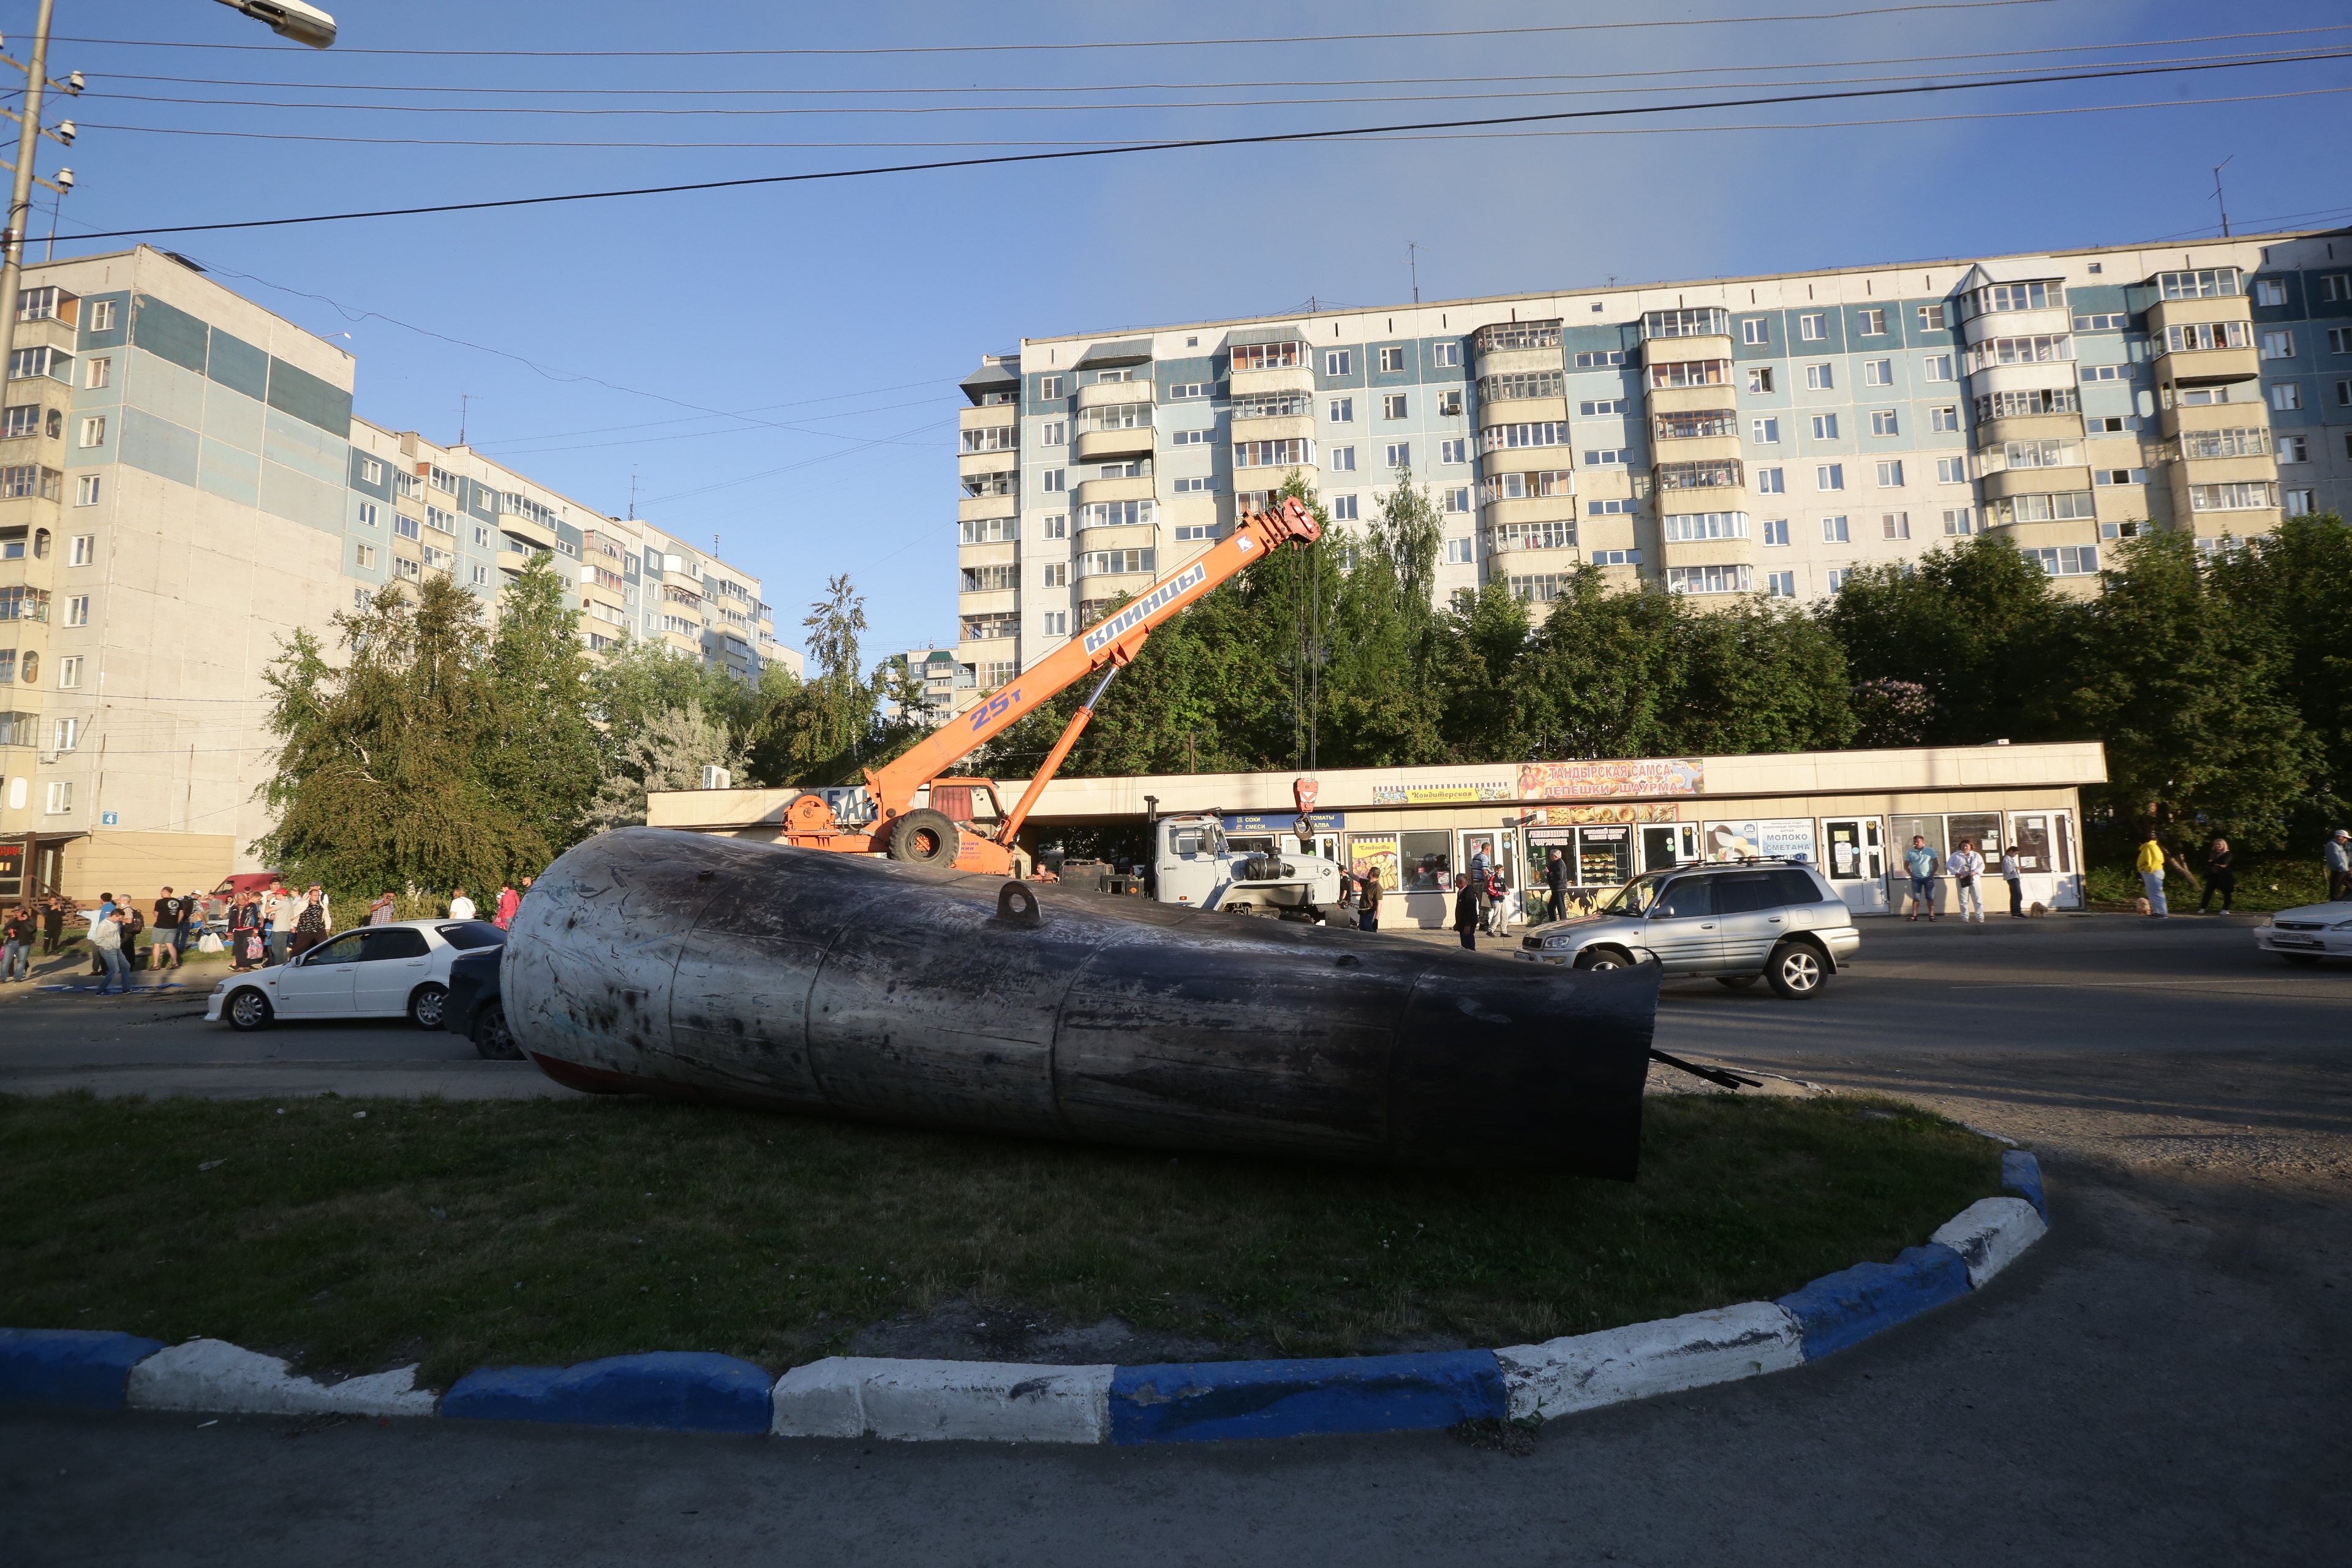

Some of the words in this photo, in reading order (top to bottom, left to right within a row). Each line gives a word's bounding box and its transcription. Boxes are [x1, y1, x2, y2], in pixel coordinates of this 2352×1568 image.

[1085, 564, 1205, 652] КЛИНЦЫ
[1549, 764, 1628, 782] ТАНДЫРСКАЯ
[1631, 764, 1672, 777] САМСА
[1411, 791, 1472, 801] Кондитерская
[1544, 785, 1610, 796] ЛЕПЕШКИ
[1619, 782, 1679, 793] ШАУРМА
[106, 815, 113, 824] 4
